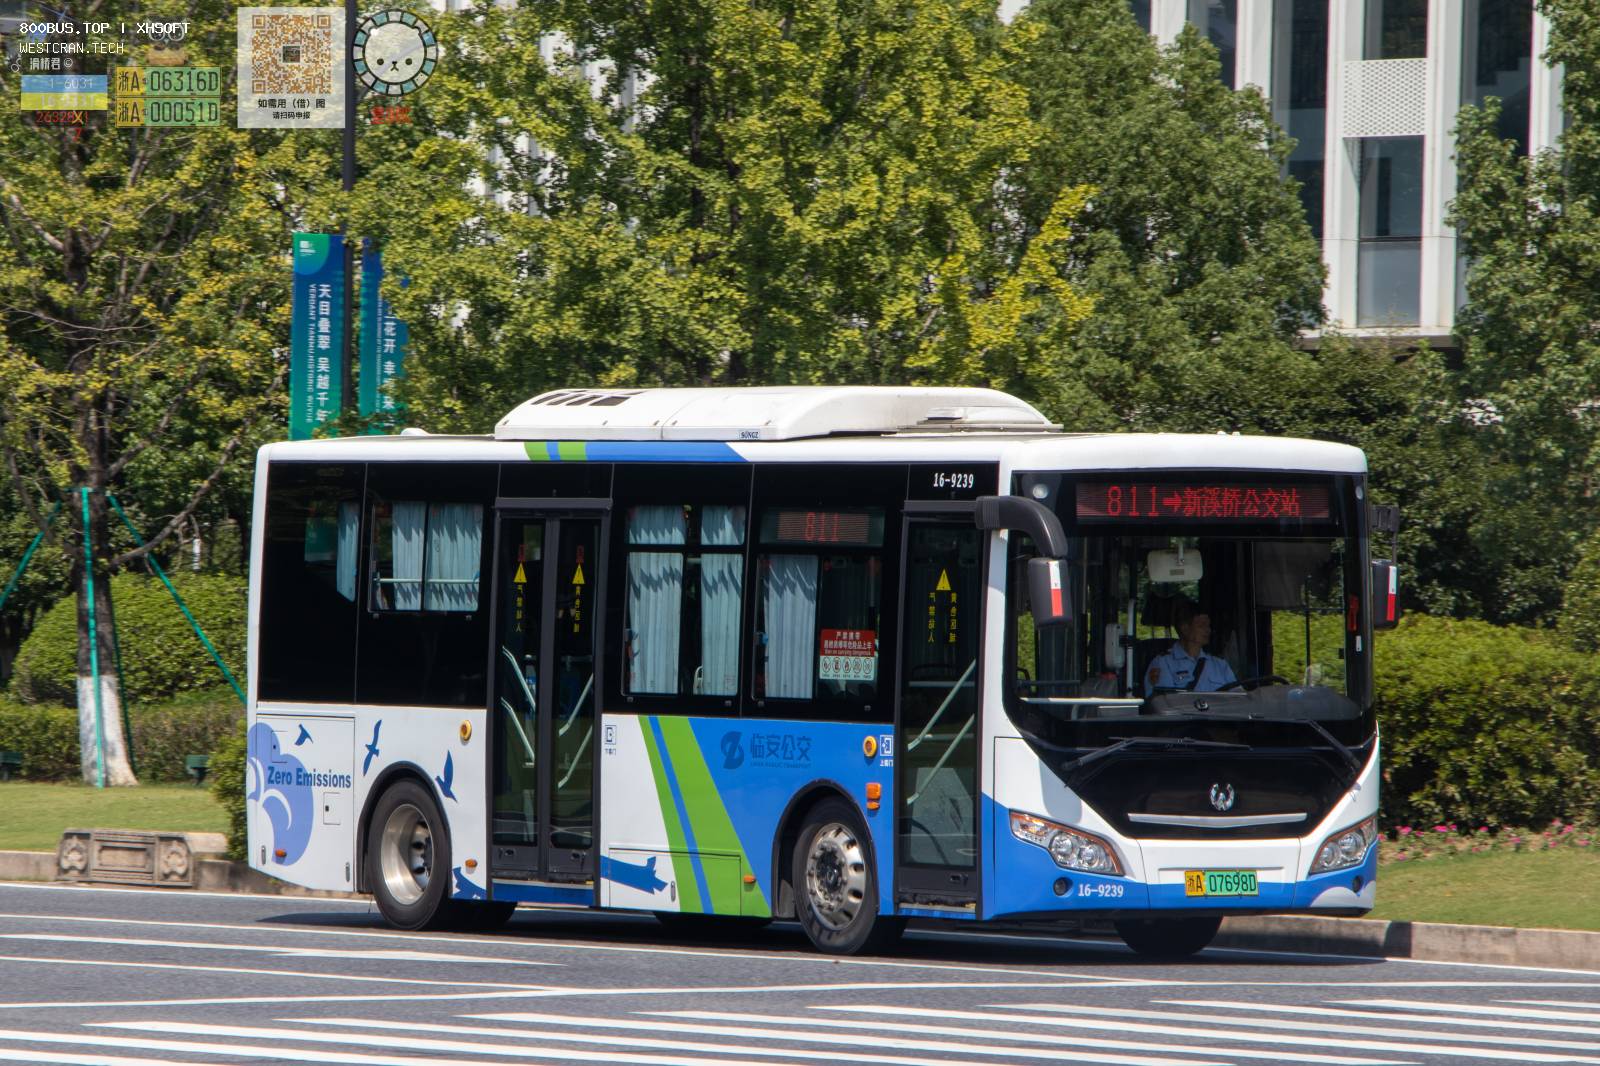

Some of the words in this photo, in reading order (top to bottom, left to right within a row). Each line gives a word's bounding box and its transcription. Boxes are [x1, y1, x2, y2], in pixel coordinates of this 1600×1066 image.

[932, 472, 975, 489] 16-9239
[1106, 485, 1160, 517] 811
[804, 511, 841, 542] 811
[750, 733, 812, 762] 临安公交
[267, 765, 293, 786] Zero
[296, 767, 352, 789] Emissions
[1077, 882, 1125, 898] 16-9239
